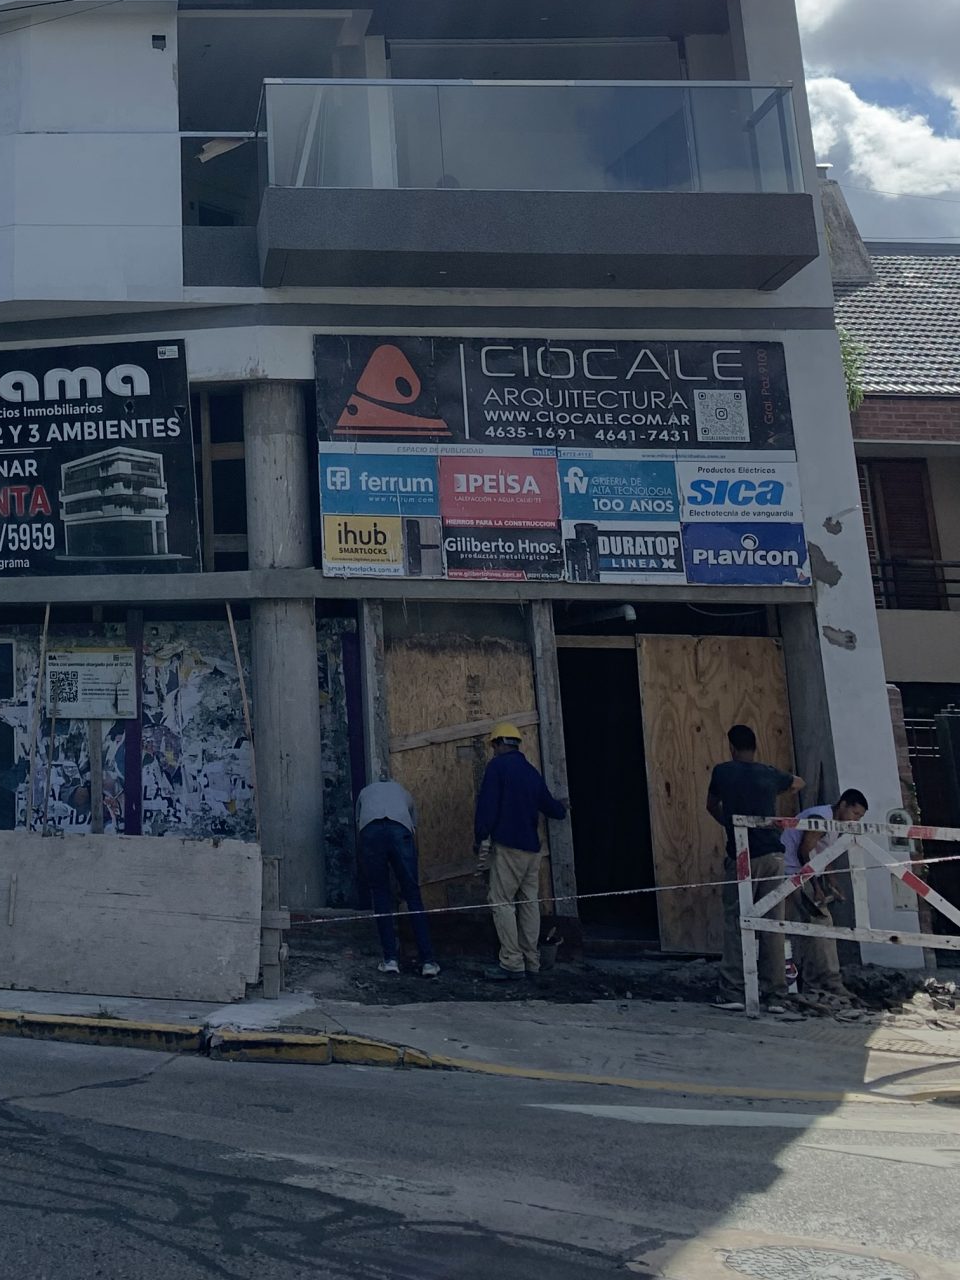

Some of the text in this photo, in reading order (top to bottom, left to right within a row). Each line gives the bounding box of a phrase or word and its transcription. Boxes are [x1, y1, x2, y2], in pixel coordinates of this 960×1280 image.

[481, 346, 744, 381] CIOCALE
[483, 388, 688, 409] ARQUITECTURA
[24, 403, 104, 418] Inmobiliarios
[484, 410, 690, 425] WWW.CIOCALE.COM.AR
[6, 425, 21, 444] Y
[28, 423, 41, 442] 3
[47, 417, 182, 442] AMBIENTES
[485, 426, 689, 442] 4635-1691 4641-7431
[441, 447, 484, 455] PUBLICIDAD
[360, 472, 434, 493] ferrum
[468, 473, 541, 494] PEISA
[631, 477, 642, 486] DE
[592, 486, 673, 496] ALTA TECNOLOGIA
[687, 479, 785, 506] sica
[593, 497, 674, 513] 100 AÑOS
[689, 509, 794, 518] Electrotecnia de vanguardia
[337, 522, 387, 545] ihub
[339, 547, 388, 555] SMARTLOCKS
[444, 537, 561, 553] Giliberto Hnos.
[598, 536, 679, 555] DURATOP
[611, 558, 658, 568] LINEA
